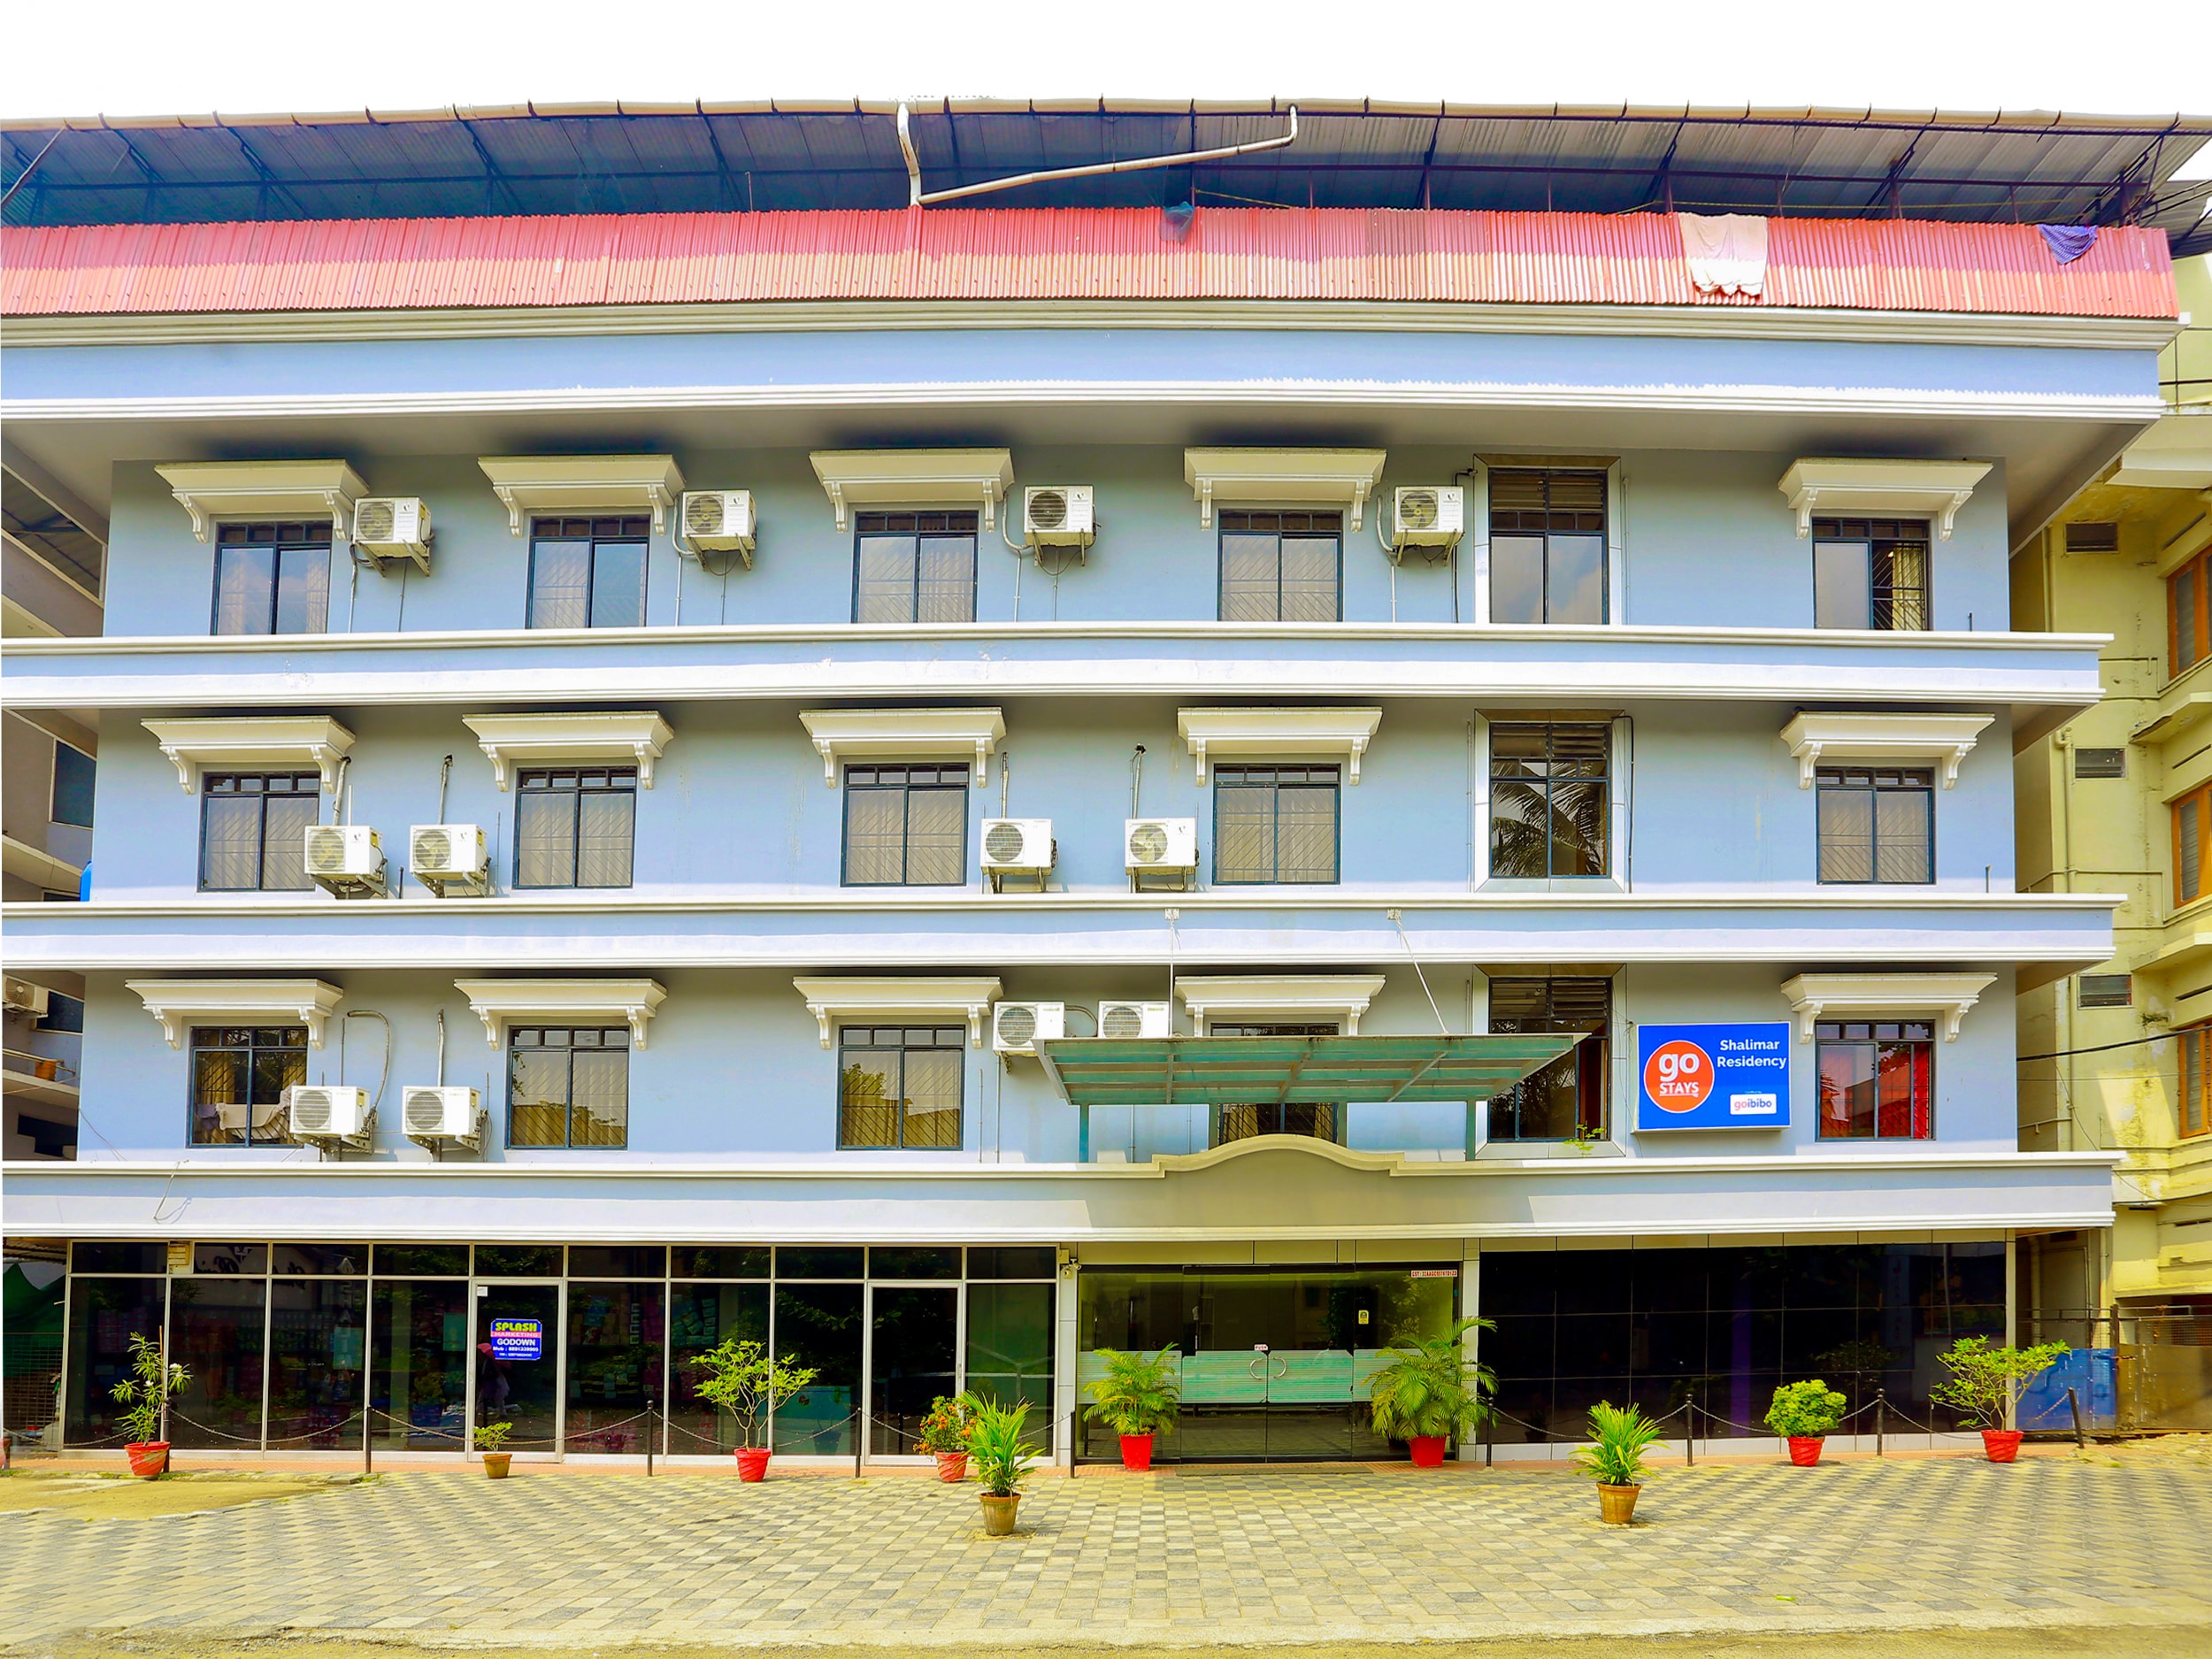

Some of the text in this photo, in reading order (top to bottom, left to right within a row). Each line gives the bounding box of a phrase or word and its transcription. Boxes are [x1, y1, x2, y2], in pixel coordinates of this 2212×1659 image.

[1720, 1040, 1780, 1051] Shalimar
[1659, 1053, 1700, 1082] go
[1717, 1056, 1786, 1069] Residency
[1660, 1082, 1699, 1094] STAYS
[1734, 1099, 1772, 1110] goibibo
[495, 1322, 537, 1332] SPLASH
